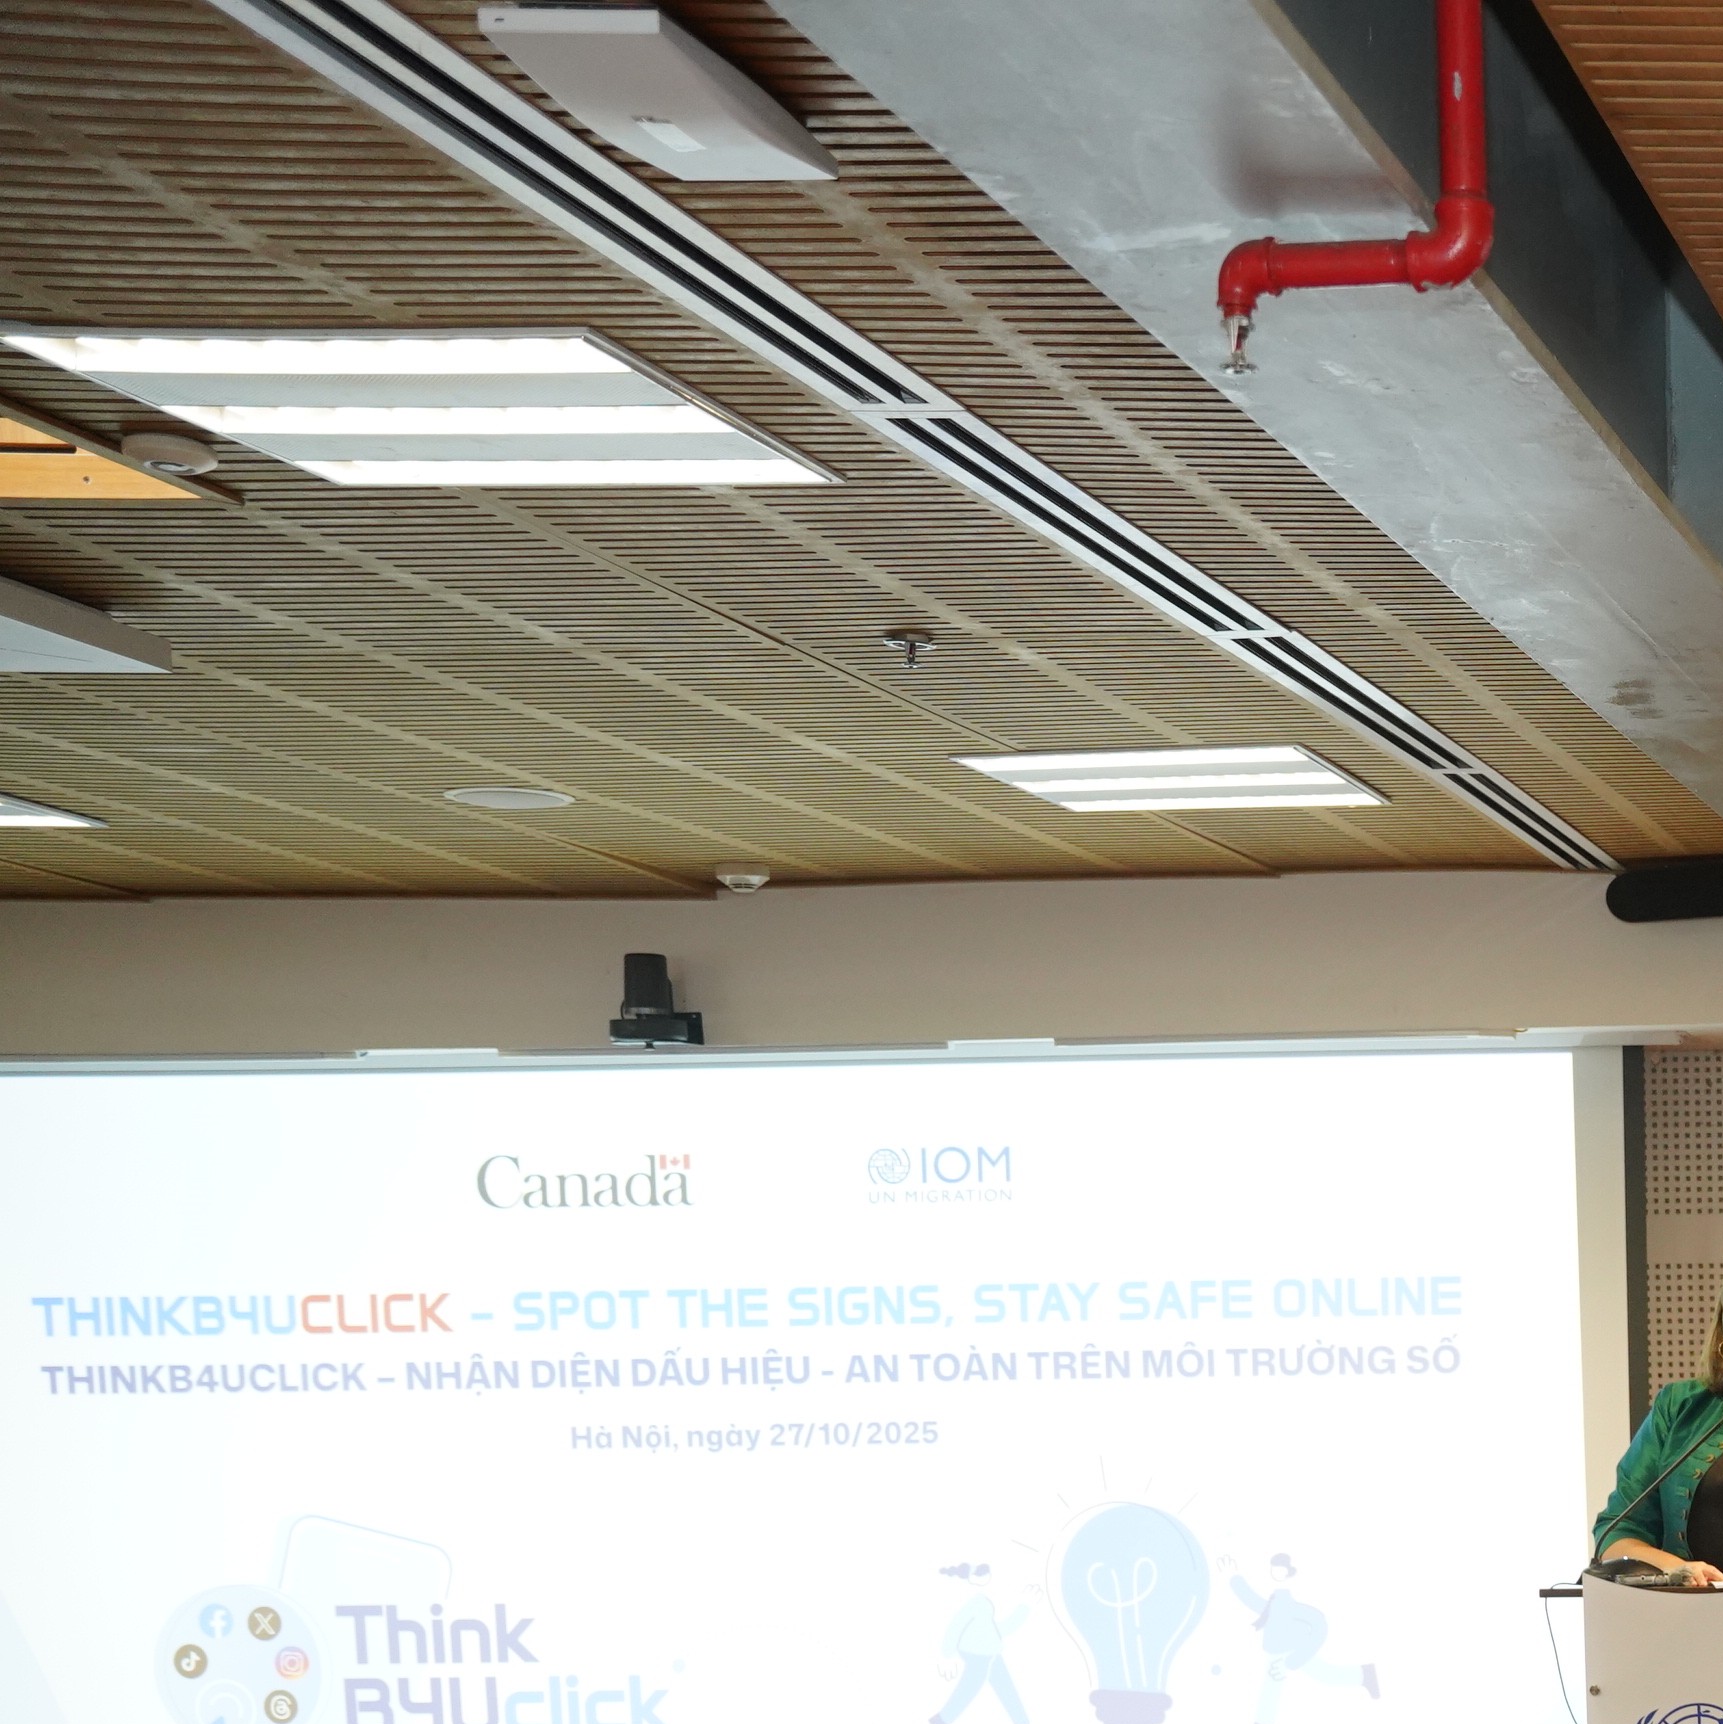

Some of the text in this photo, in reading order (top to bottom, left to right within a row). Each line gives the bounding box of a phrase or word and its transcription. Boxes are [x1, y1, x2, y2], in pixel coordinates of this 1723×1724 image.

[477, 1155, 691, 1208] Canada
[921, 1146, 1010, 1183] IOM
[869, 1189, 1012, 1204] UN MIGRATION
[31, 1293, 452, 1337] THINKB4UCLICK
[513, 1290, 650, 1331] SPOT
[667, 1288, 768, 1328] THE
[788, 1285, 953, 1327] SIGNS,
[974, 1283, 1099, 1323] STAY
[1118, 1280, 1252, 1320] SAFE
[1273, 1276, 1461, 1318] ONLINE
[40, 1363, 365, 1394] THINKB4UCLICK
[406, 1352, 520, 1396] NHẬN
[531, 1352, 620, 1394] DIỆN
[631, 1347, 710, 1387] DẤU
[721, 1348, 810, 1391] HIỆU
[846, 1355, 899, 1383] AN
[909, 1349, 1017, 1383] TOÀN
[1027, 1343, 1130, 1380] TRÊN
[1142, 1342, 1214, 1378] MÔI
[1226, 1339, 1395, 1376] TRƯỜNG
[1407, 1337, 1460, 1374] SỐ
[571, 1421, 938, 1453] Hà Nội, ngày 27/10/2025
[335, 1604, 538, 1665] Think
